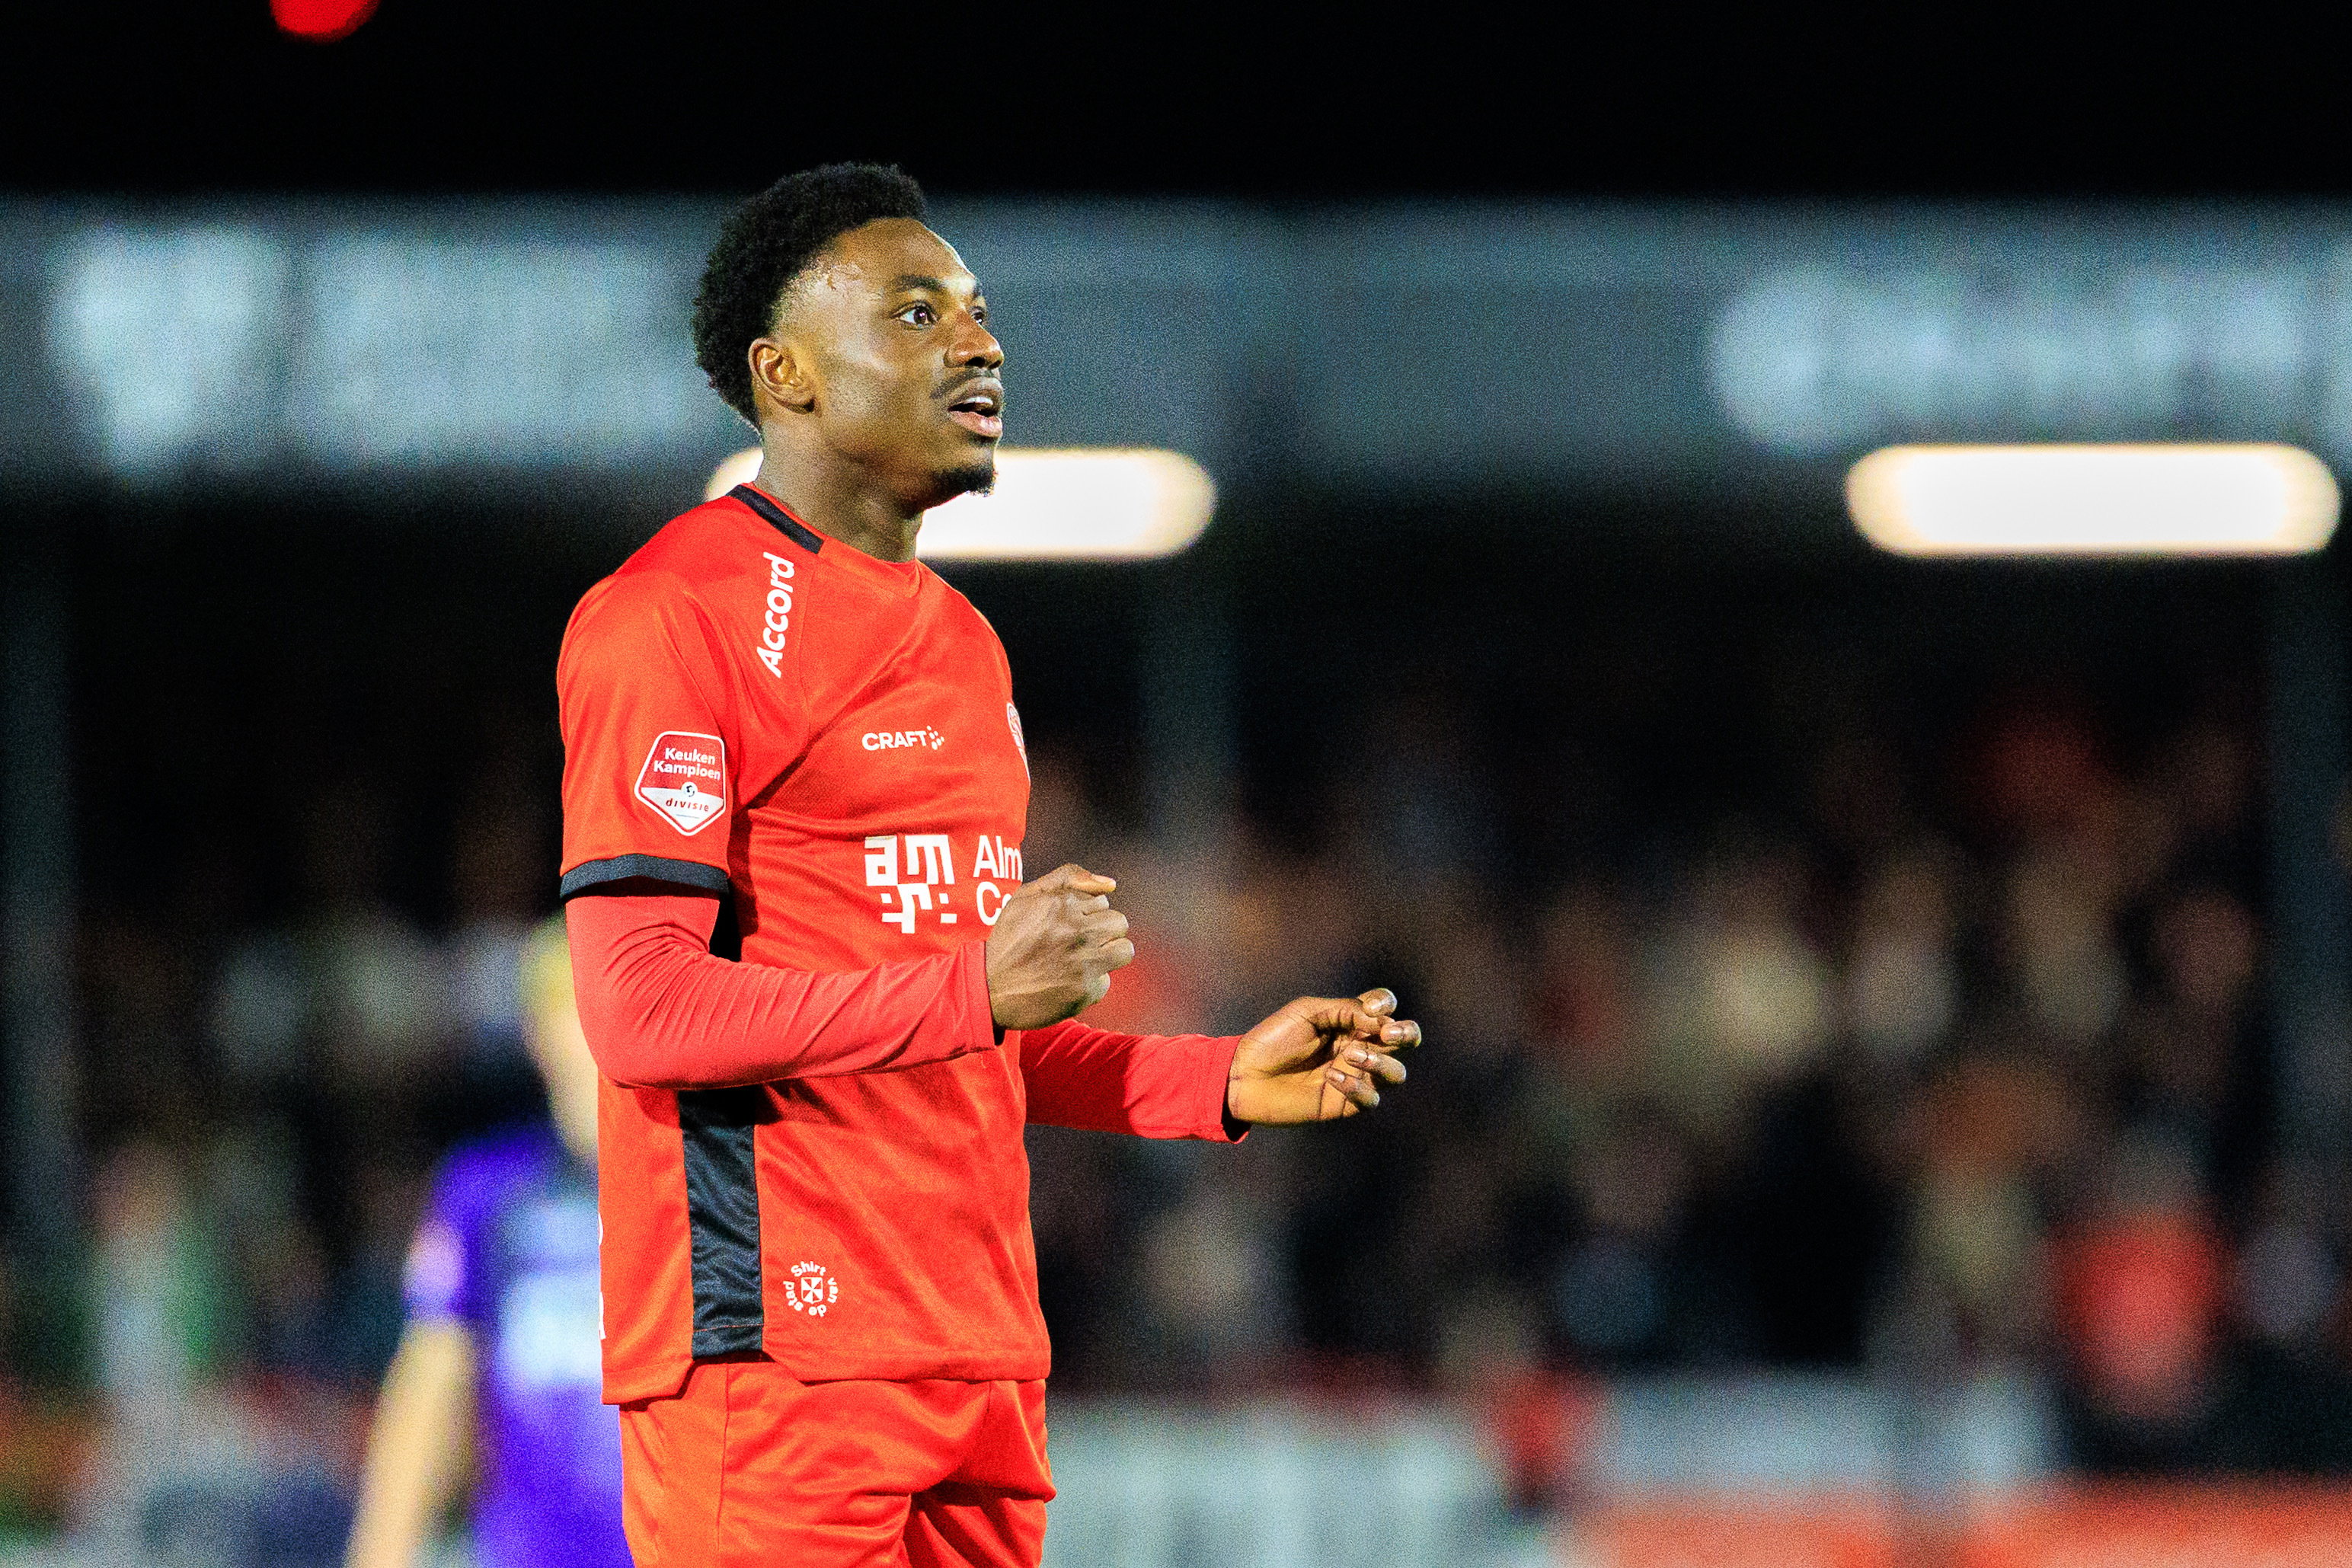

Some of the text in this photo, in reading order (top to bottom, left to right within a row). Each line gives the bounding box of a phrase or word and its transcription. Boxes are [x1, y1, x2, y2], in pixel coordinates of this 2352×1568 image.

[756, 551, 795, 679] Accord
[861, 730, 927, 751] CRAFT
[664, 747, 716, 765] Keuken
[653, 760, 721, 781] Kampioen
[665, 798, 709, 812] divisie
[782, 1260, 839, 1317] Shirt van de stad
